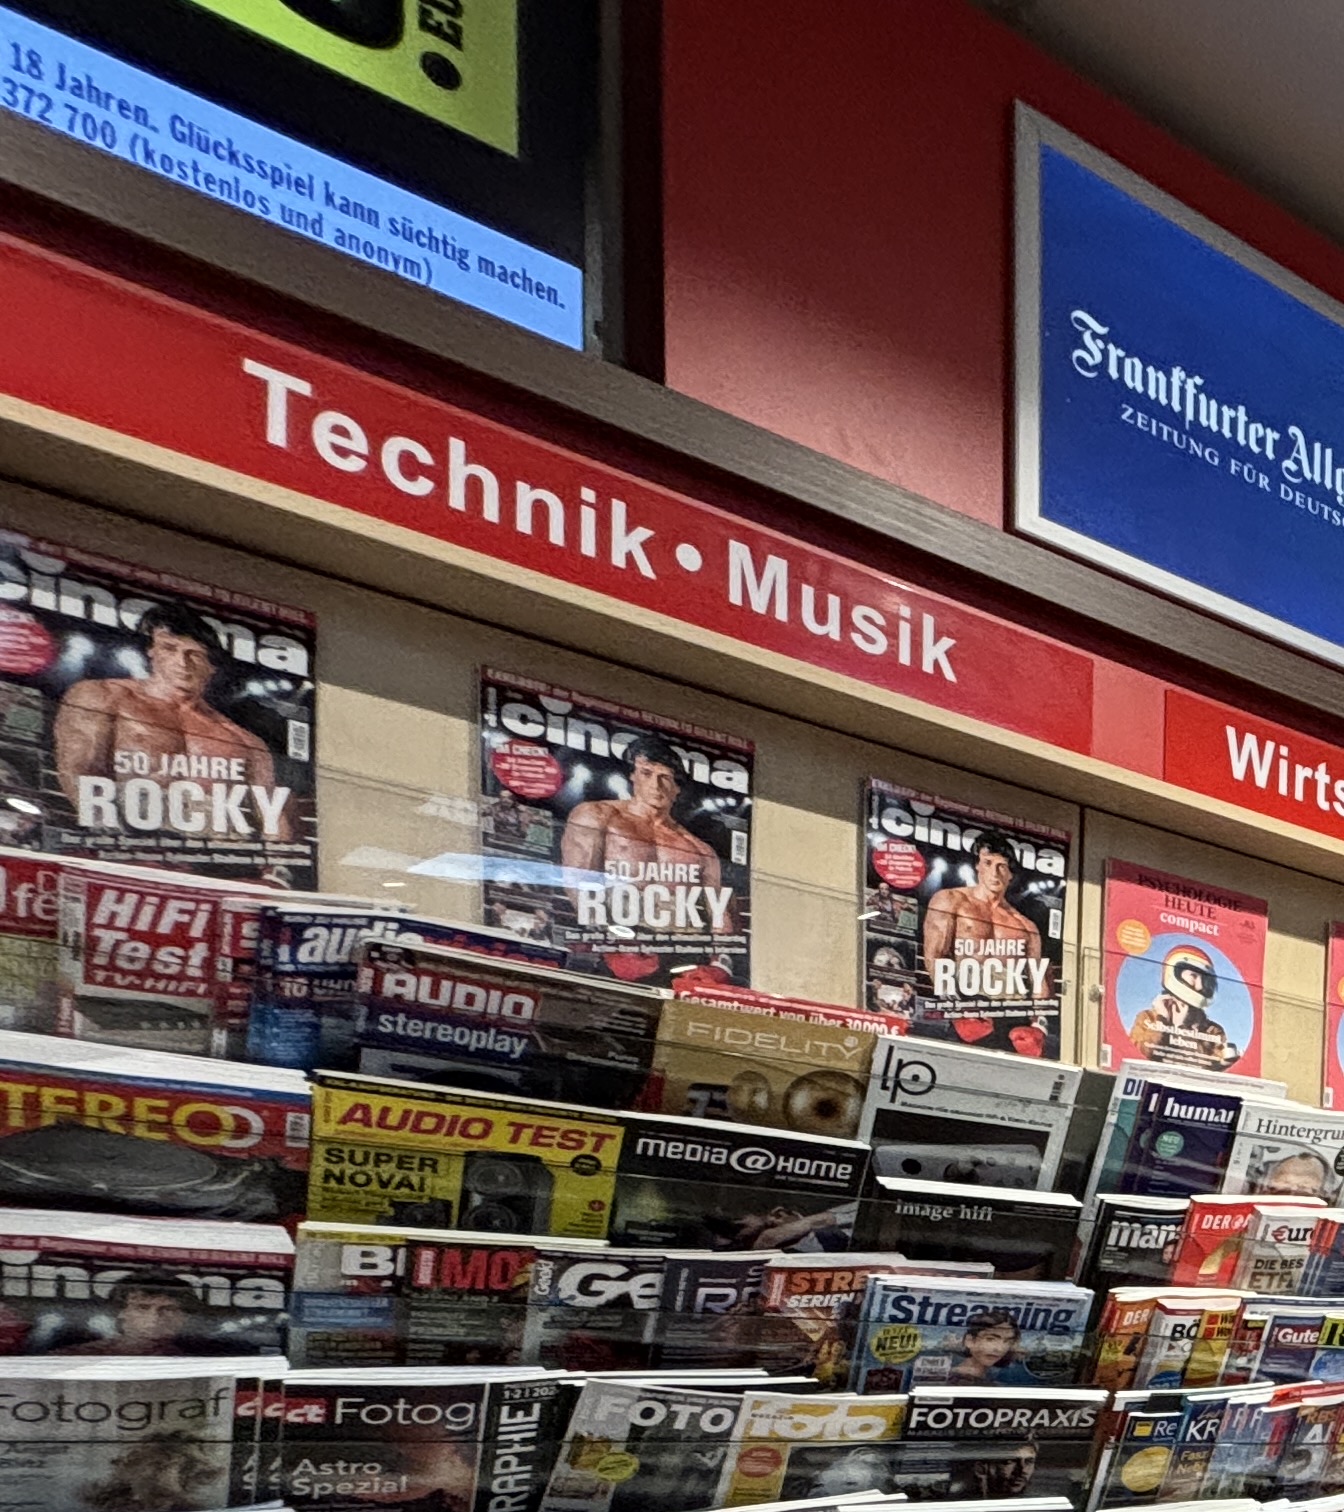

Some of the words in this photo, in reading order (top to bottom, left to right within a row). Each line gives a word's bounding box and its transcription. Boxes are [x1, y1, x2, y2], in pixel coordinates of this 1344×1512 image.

[8, 41, 45, 80] 18
[55, 62, 160, 135] Jahren.
[170, 114, 316, 200] Glücksspiel
[324, 180, 381, 229] kann
[389, 213, 471, 271] süchtig
[478, 253, 567, 310] machen.
[64, 103, 118, 151] 700
[129, 134, 273, 217] (kostenlos
[280, 200, 325, 239] und
[334, 225, 434, 289] anonym)
[1069, 308, 1284, 465] Frankfurter
[1120, 403, 1221, 470] ZEITUNG
[1229, 456, 1273, 495] FÜR
[242, 357, 656, 581] Technik
[727, 538, 958, 684] Musik
[113, 750, 150, 774] 50
[156, 754, 245, 781] JAHRE
[77, 775, 292, 838] ROCKY
[604, 859, 630, 882] 50
[635, 861, 701, 885] JAHRE
[576, 882, 734, 929] ROCKY
[1159, 910, 1220, 937] compact
[1164, 896, 1217, 921] HEUTE
[92, 928, 210, 979] Test
[954, 937, 974, 956] 50
[977, 937, 1026, 959] JAHRE
[380, 969, 536, 1020] AUDIO
[934, 956, 1051, 998] ROCKY
[377, 1011, 528, 1059] stereoplay
[686, 1021, 864, 1059] FIDELITY
[337, 1101, 495, 1141] AUDIO
[506, 1119, 616, 1155] TEST
[322, 1148, 439, 1174] SUPER
[895, 1200, 952, 1222] image
[889, 1293, 1077, 1334] Streaming
[875, 1333, 918, 1354] NEU!
[909, 1406, 1097, 1431] FOTOPRAXIS
[292, 1473, 408, 1499] Spezial
[294, 1458, 382, 1478] Astro
